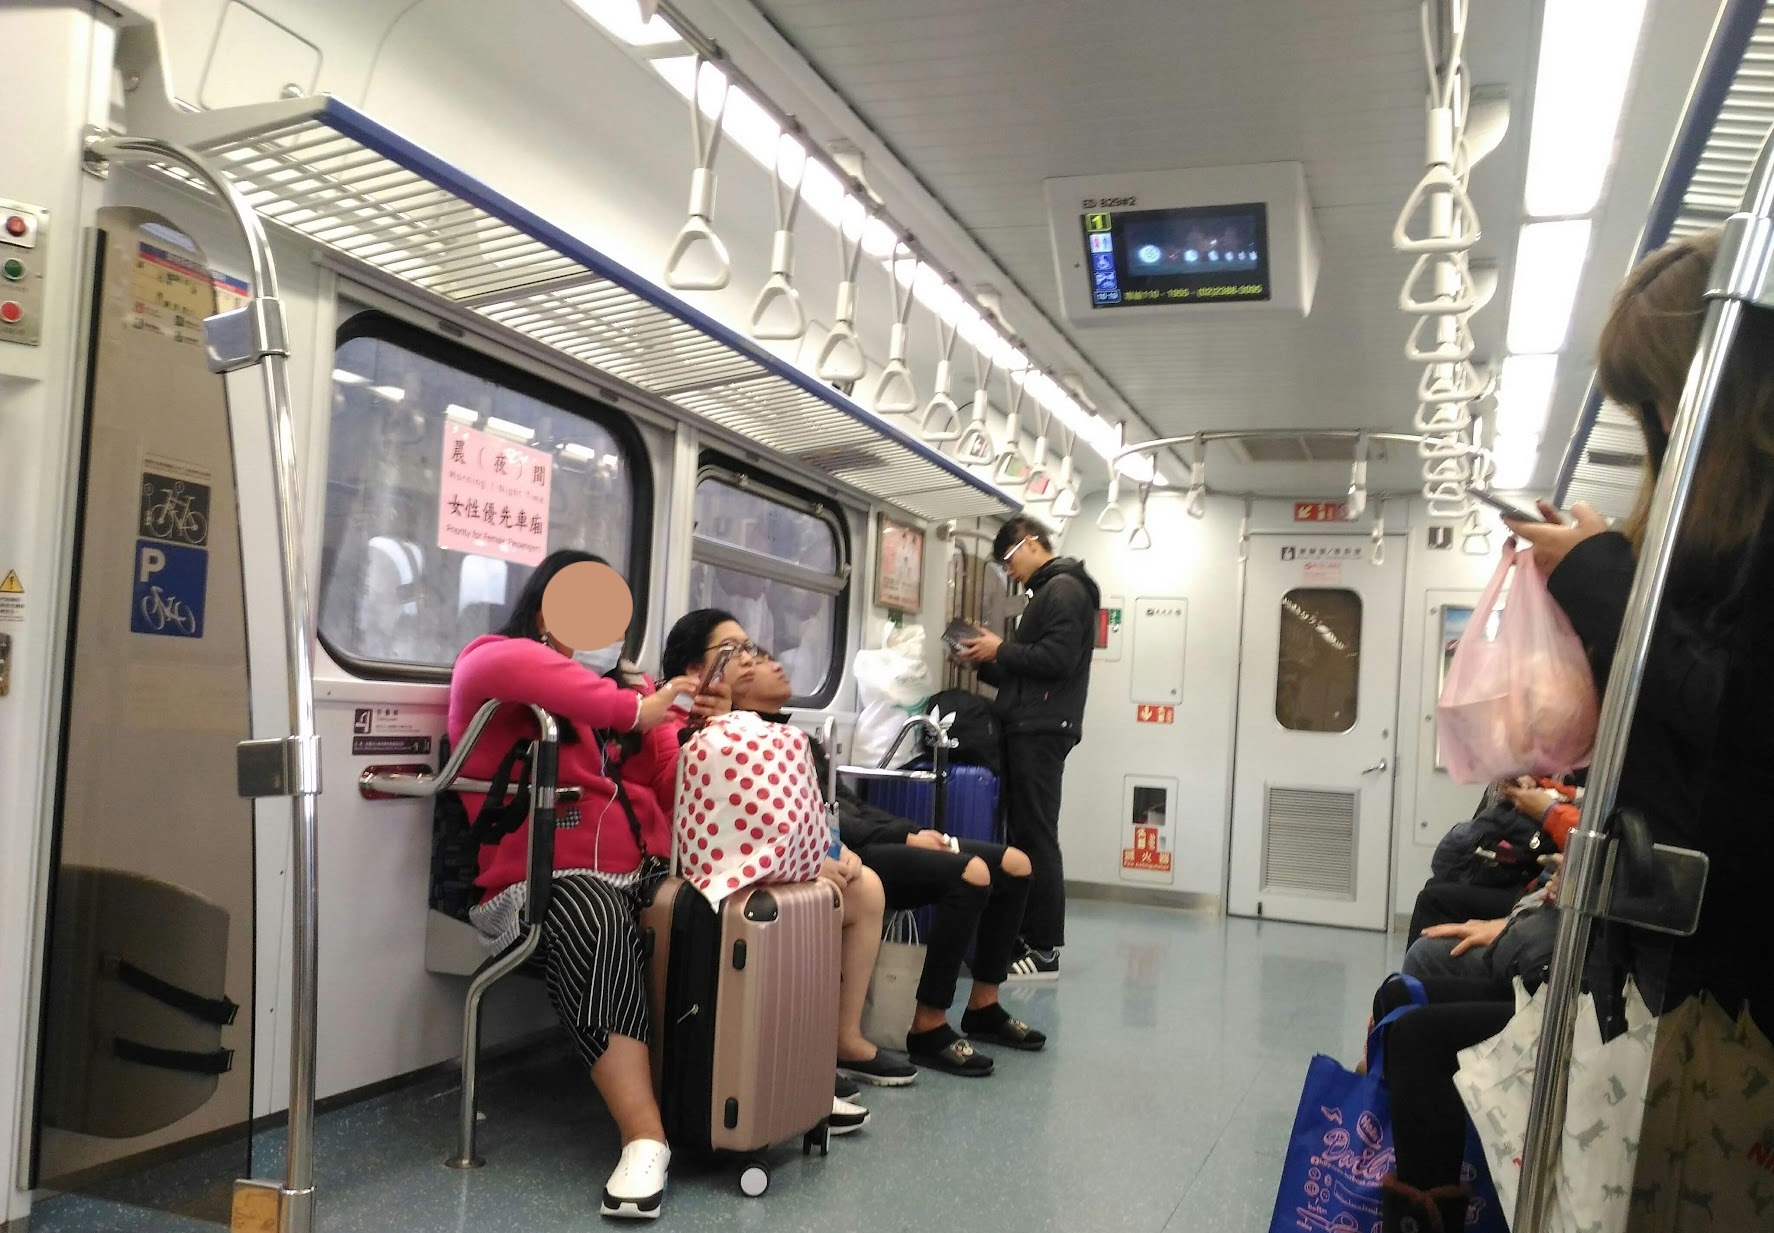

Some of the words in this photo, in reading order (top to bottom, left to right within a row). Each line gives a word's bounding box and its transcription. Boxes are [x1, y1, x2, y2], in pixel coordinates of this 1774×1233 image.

[1091, 214, 1103, 230] 1
[449, 470, 486, 490] Morning
[448, 494, 543, 535] 女性優先車廂
[140, 547, 166, 583] P
